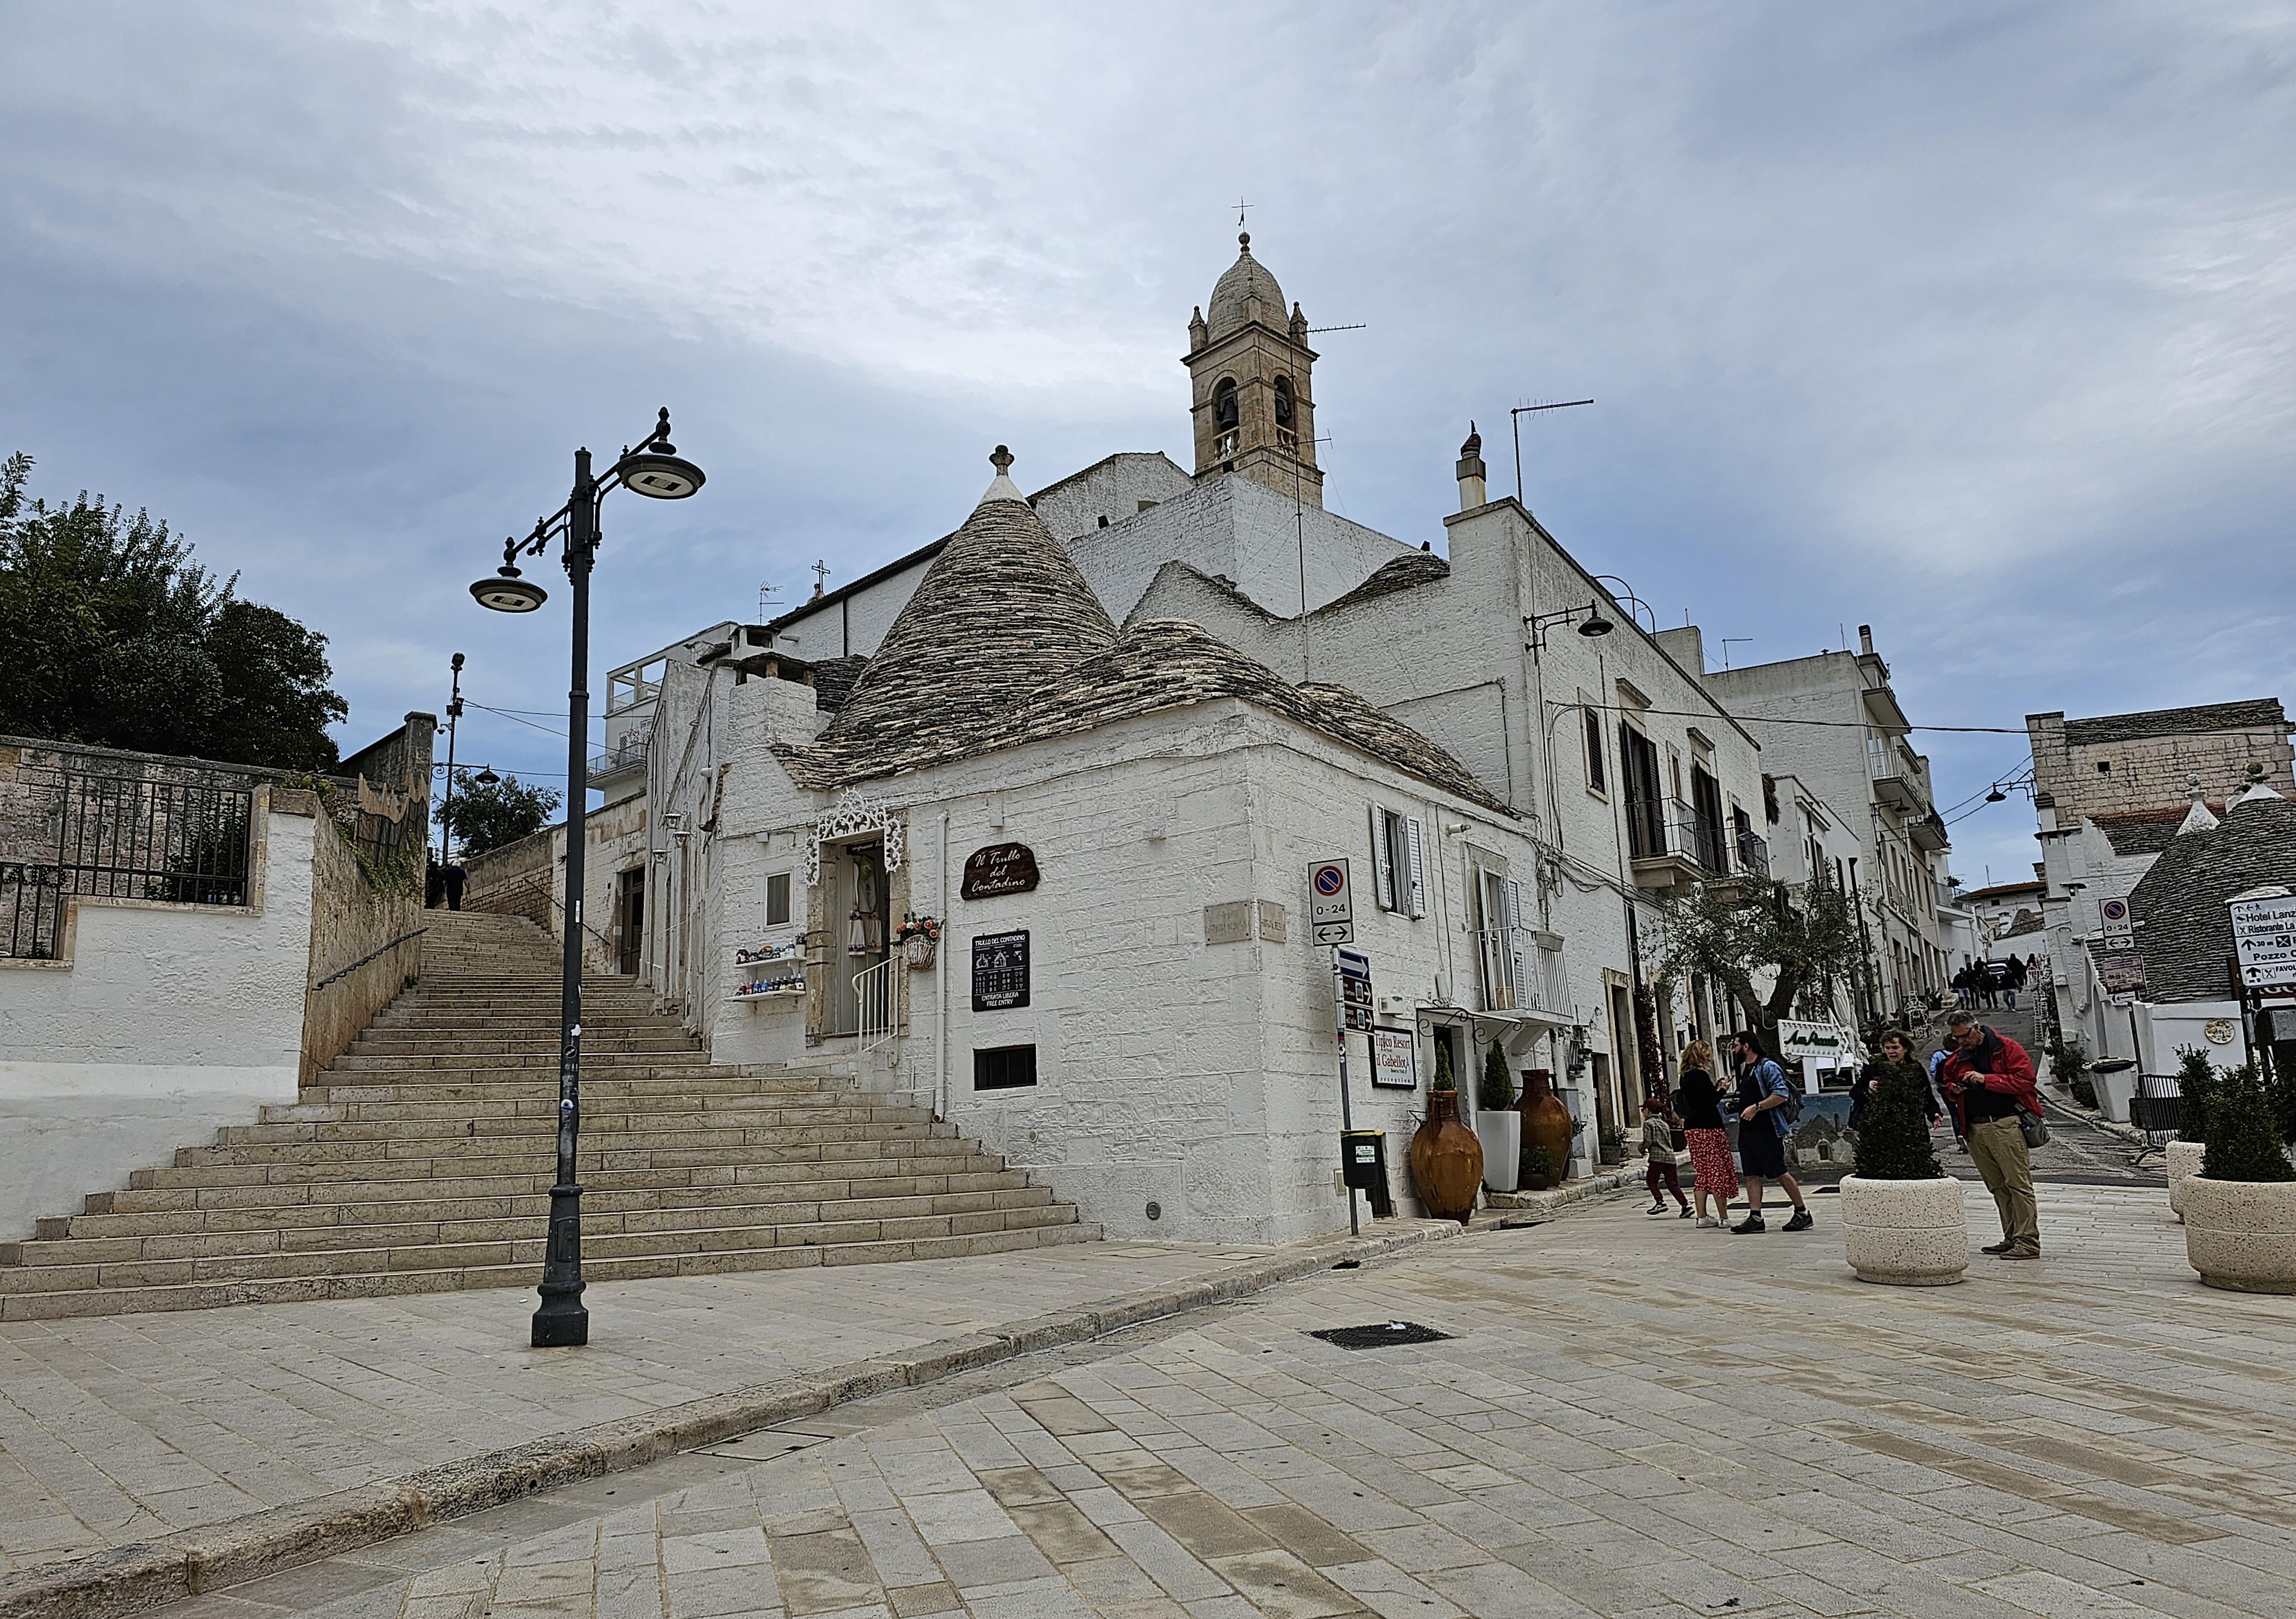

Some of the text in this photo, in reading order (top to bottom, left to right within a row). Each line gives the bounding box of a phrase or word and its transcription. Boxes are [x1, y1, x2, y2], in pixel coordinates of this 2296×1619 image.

[975, 849, 1020, 867] Il Trullo
[989, 864, 1007, 877] del
[972, 876, 1025, 892] Contadino
[2246, 908, 2296, 922] Hotel Lanz
[2248, 922, 2295, 934] Ristorante La
[1000, 935, 1025, 943] CONTADINO
[2253, 953, 2287, 961] Pozzo
[1392, 1035, 1411, 1049] Resort
[1376, 1053, 1380, 1066] il
